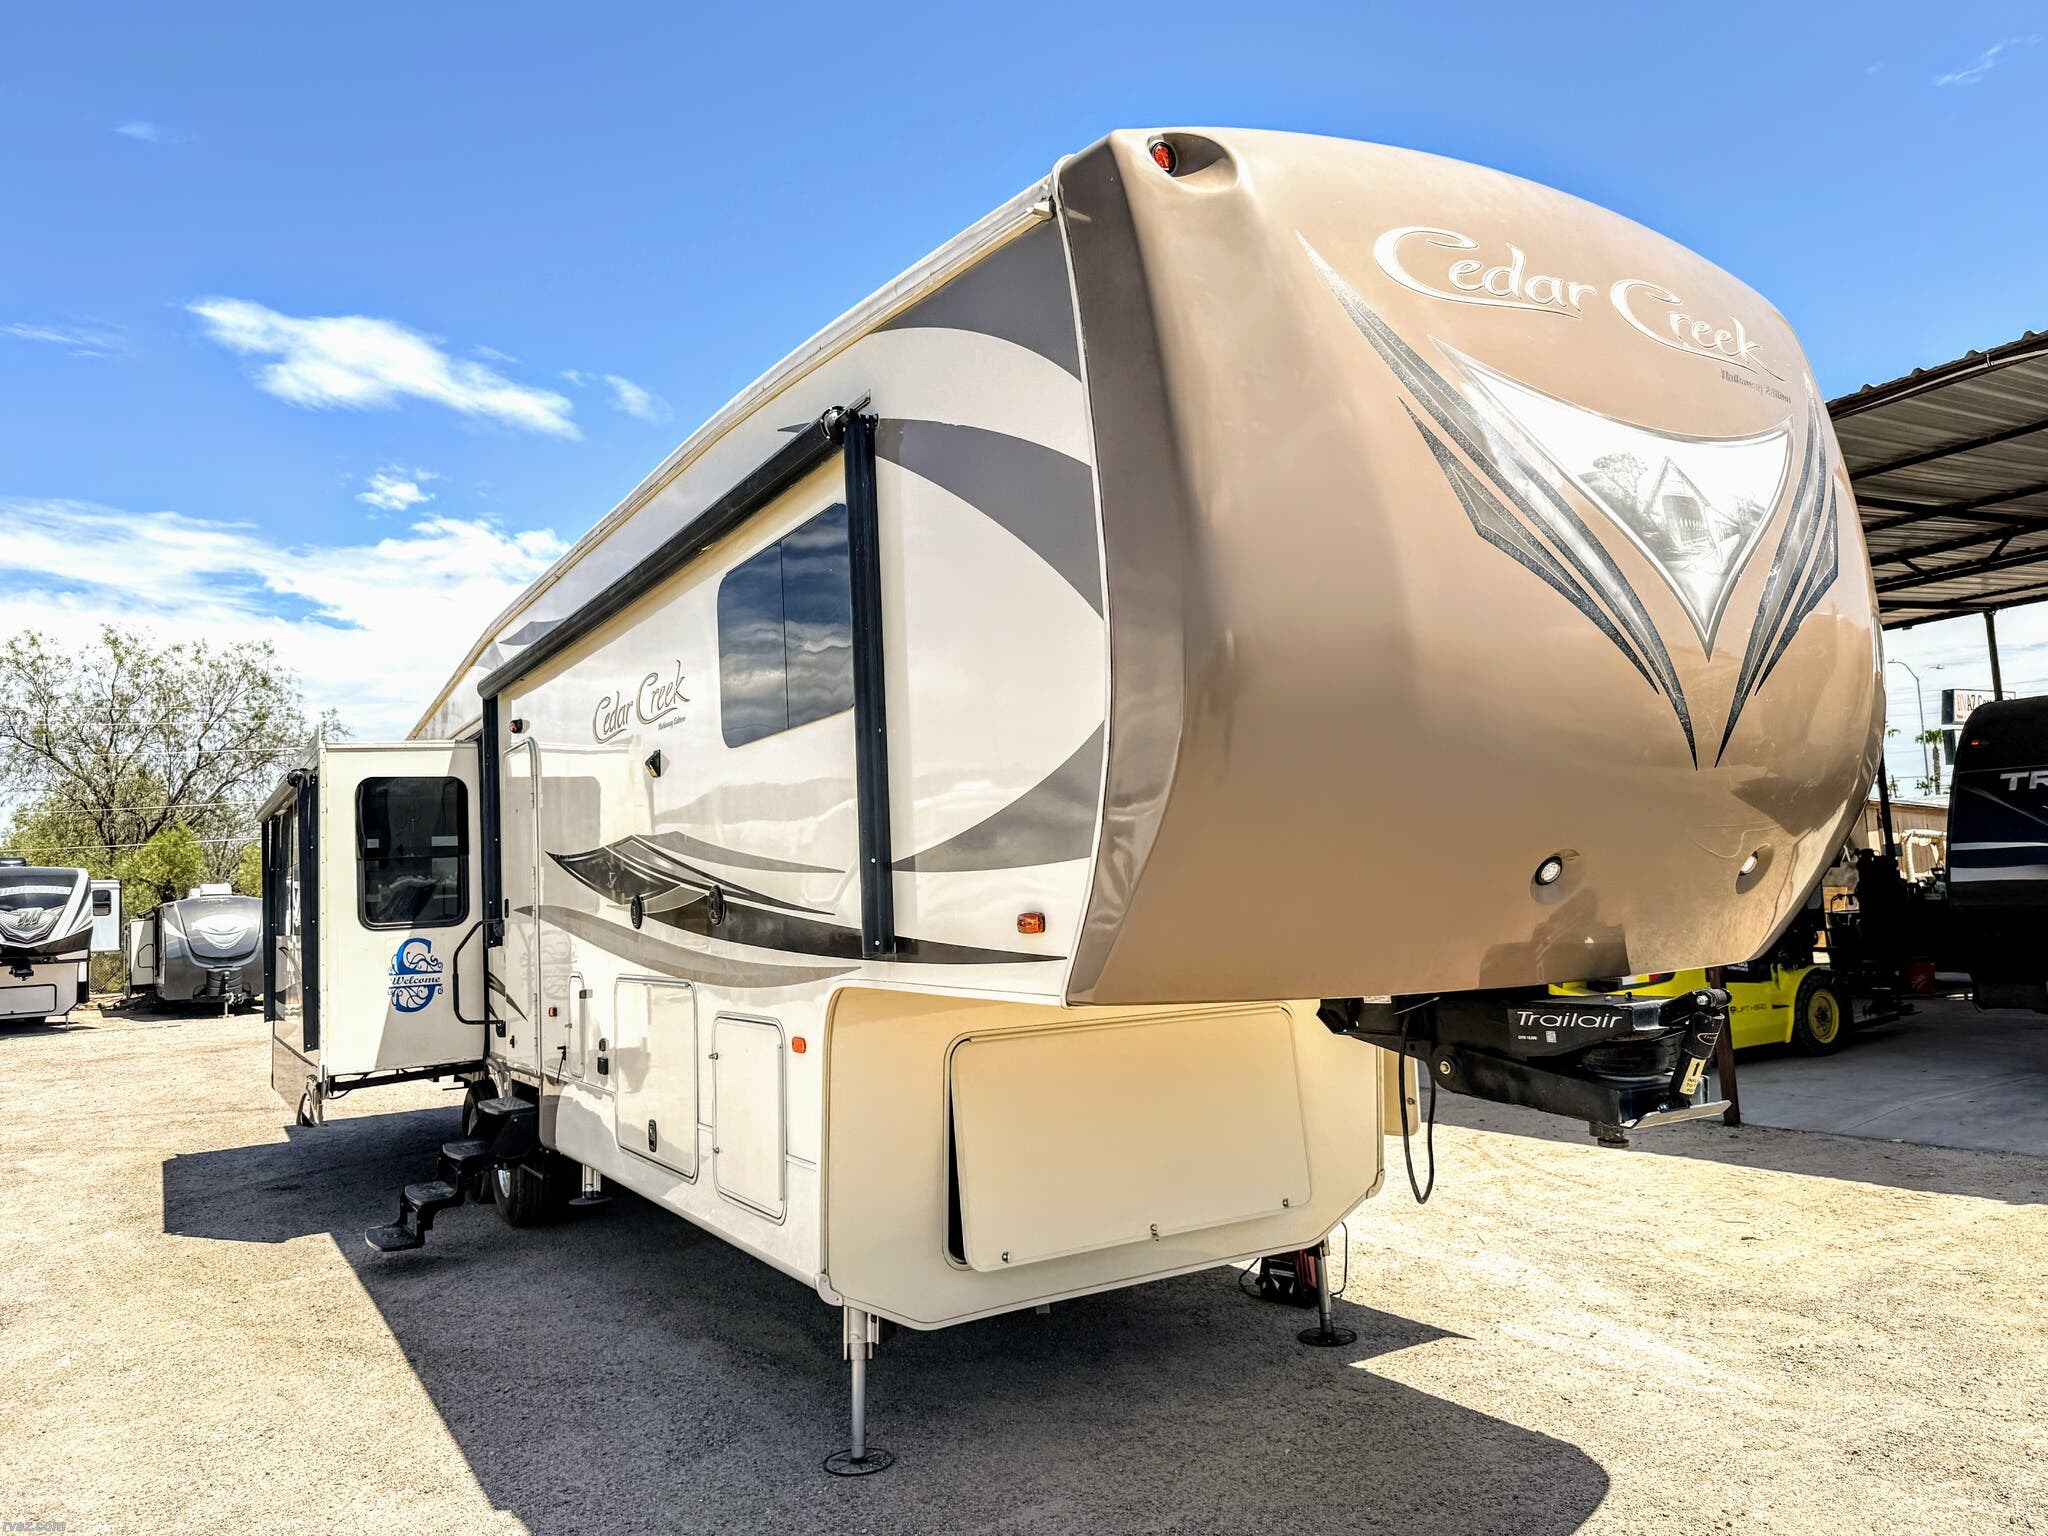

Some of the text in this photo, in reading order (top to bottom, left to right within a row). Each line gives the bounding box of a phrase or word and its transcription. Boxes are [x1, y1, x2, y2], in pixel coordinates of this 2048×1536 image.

[1373, 226, 1786, 382] Cedar Creek
[593, 660, 690, 744] Cedar Creek
[391, 976, 441, 986] Welcome
[1516, 1011, 1624, 1028] Trailair
